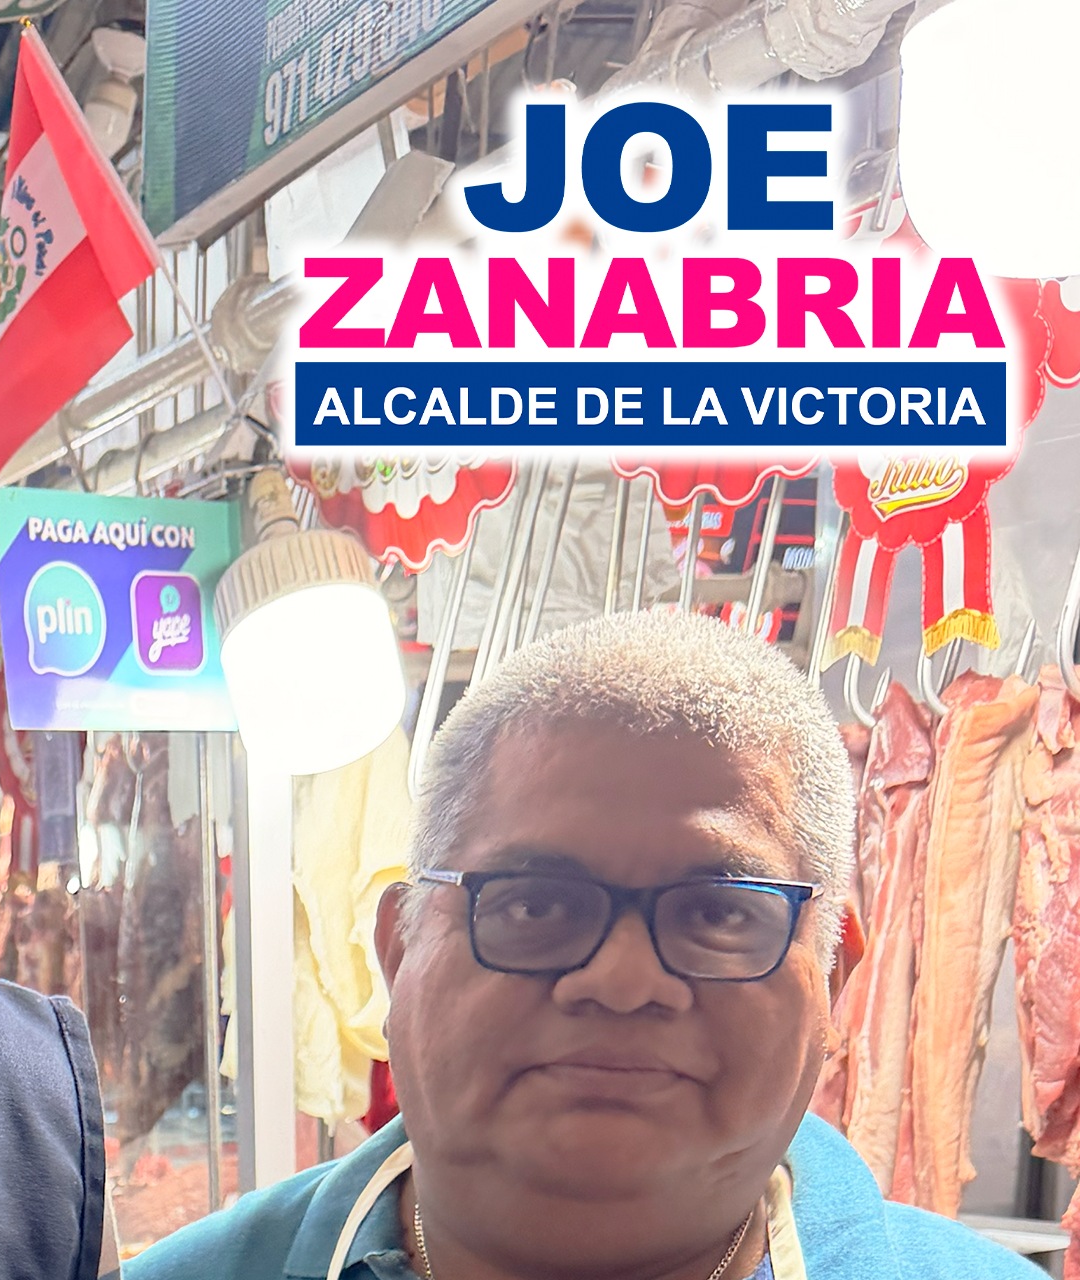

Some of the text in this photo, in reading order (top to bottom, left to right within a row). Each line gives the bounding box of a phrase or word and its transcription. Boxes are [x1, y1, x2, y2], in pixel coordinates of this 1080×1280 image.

[264, 48, 310, 146] 971
[27, 517, 90, 544] PAGA
[151, 523, 196, 549] CON
[36, 597, 94, 644] plin
